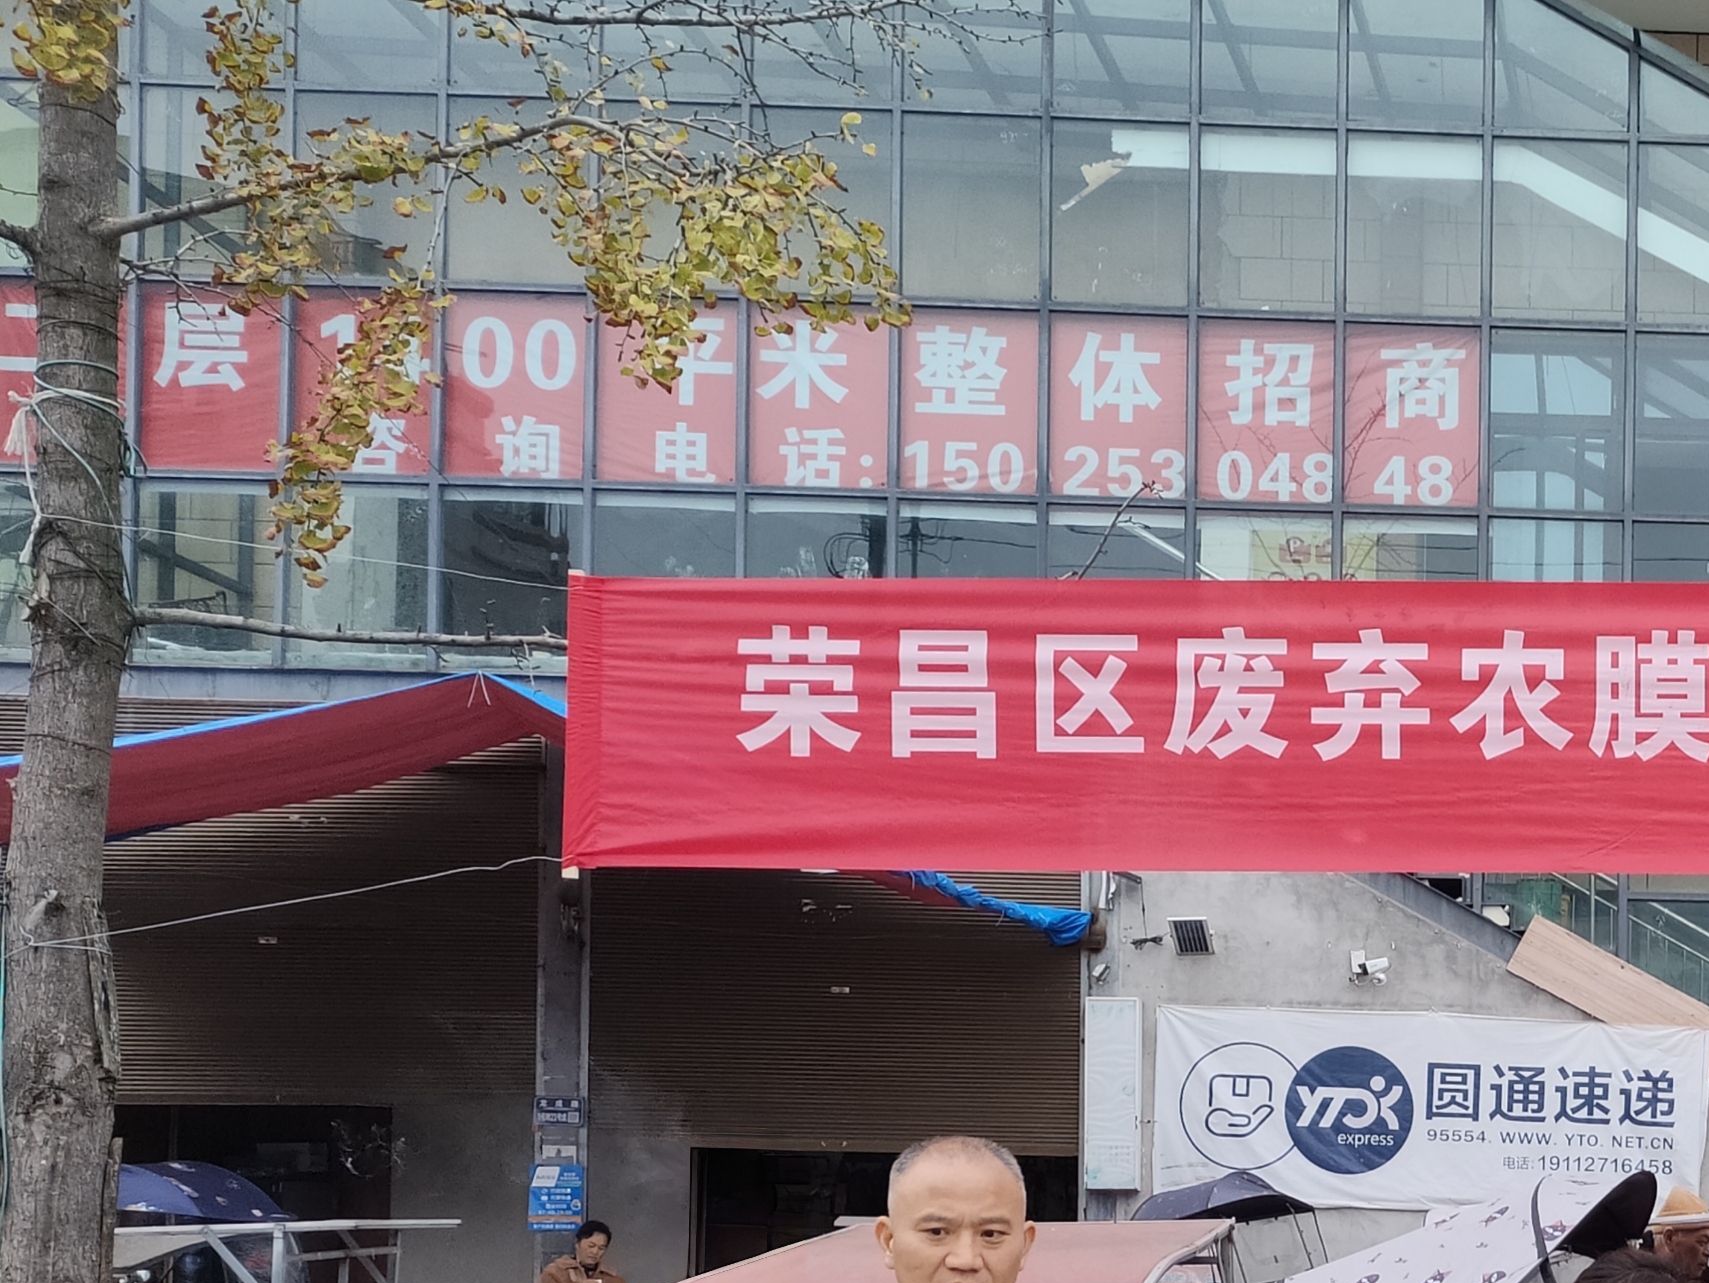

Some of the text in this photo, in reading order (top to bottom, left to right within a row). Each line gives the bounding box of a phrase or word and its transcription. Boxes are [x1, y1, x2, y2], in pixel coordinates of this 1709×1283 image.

[904, 441, 1024, 494] 150
[1063, 446, 1185, 498] 253
[1217, 451, 1334, 503] 048
[1373, 455, 1455, 506] 48
[1425, 1062, 1676, 1128] 圆通速递
[1337, 1132, 1395, 1149] express
[1611, 1135, 1675, 1152] NET.CN
